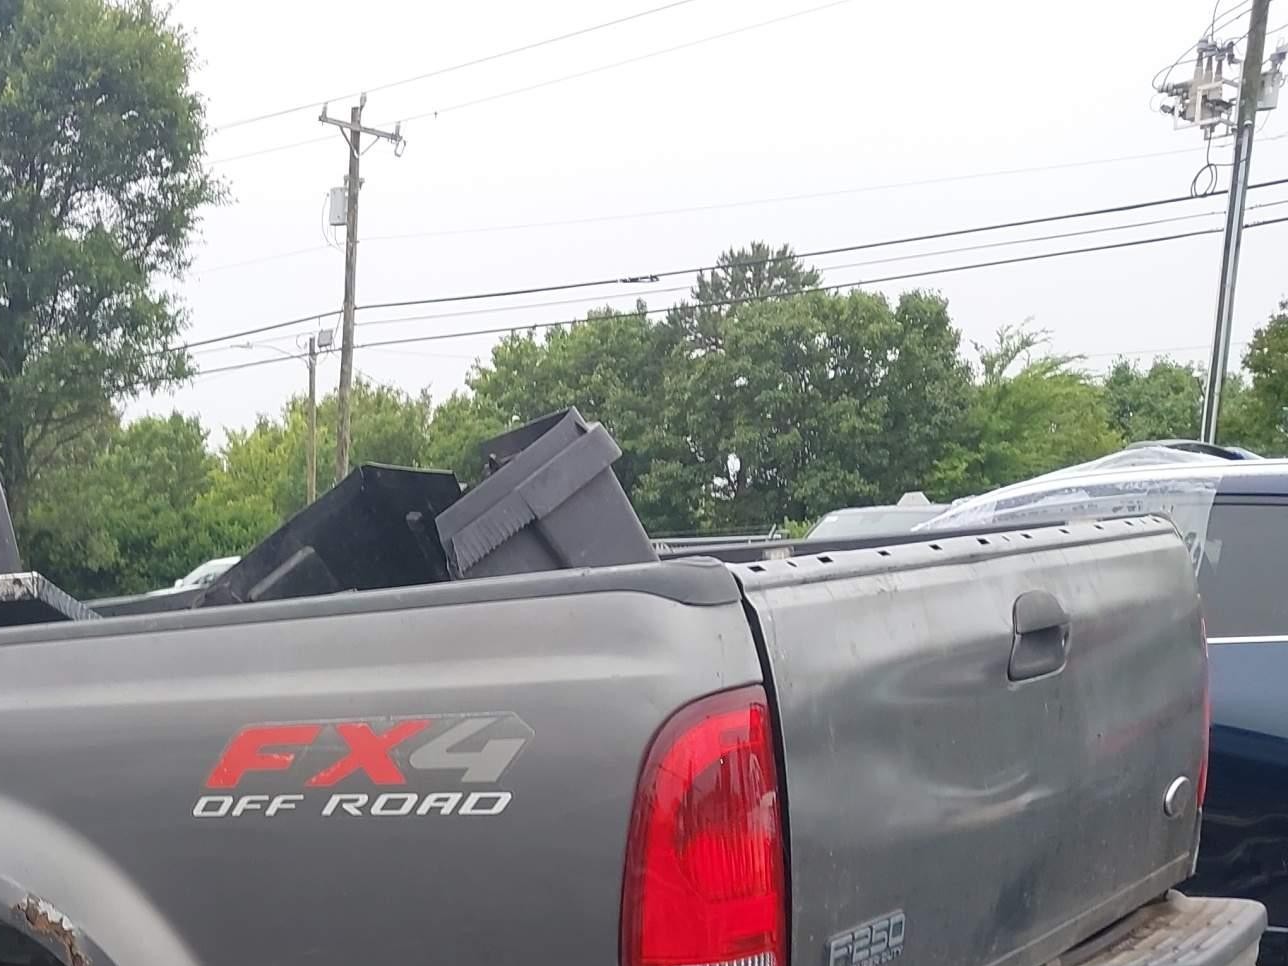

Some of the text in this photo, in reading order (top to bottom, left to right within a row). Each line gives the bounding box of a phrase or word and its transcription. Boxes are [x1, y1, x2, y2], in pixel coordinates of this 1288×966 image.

[205, 718, 526, 789] FX4
[193, 792, 511, 816] OFF ROAD
